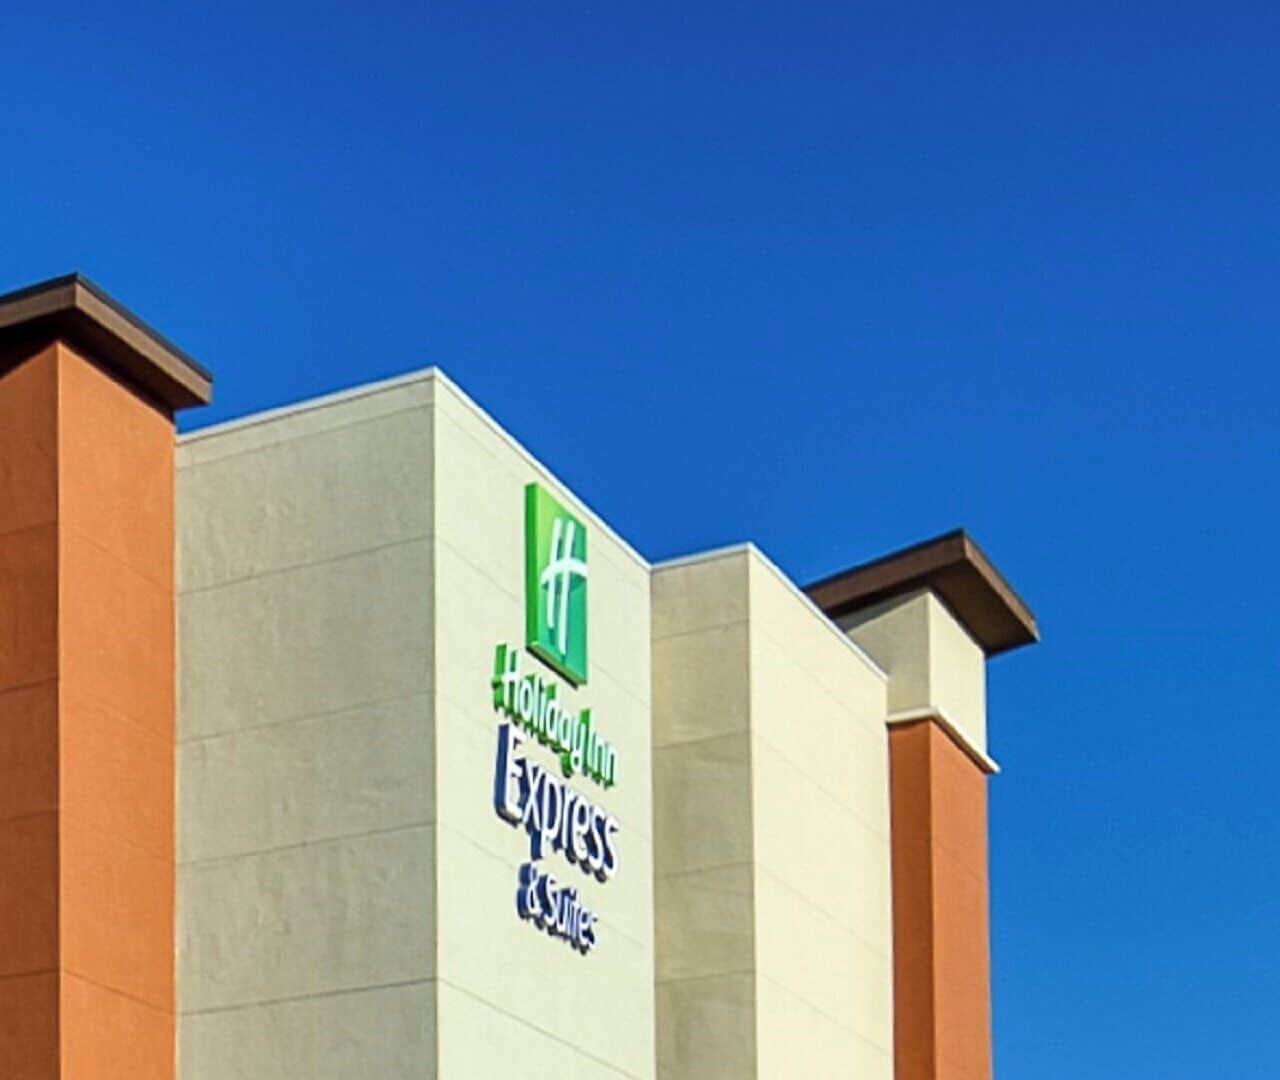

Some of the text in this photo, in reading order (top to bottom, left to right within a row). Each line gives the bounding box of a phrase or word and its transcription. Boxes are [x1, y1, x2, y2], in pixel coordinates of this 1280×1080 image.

[495, 643, 618, 786] Holiday Inn
[495, 724, 620, 880] Express
[520, 862, 598, 953] & Suites
